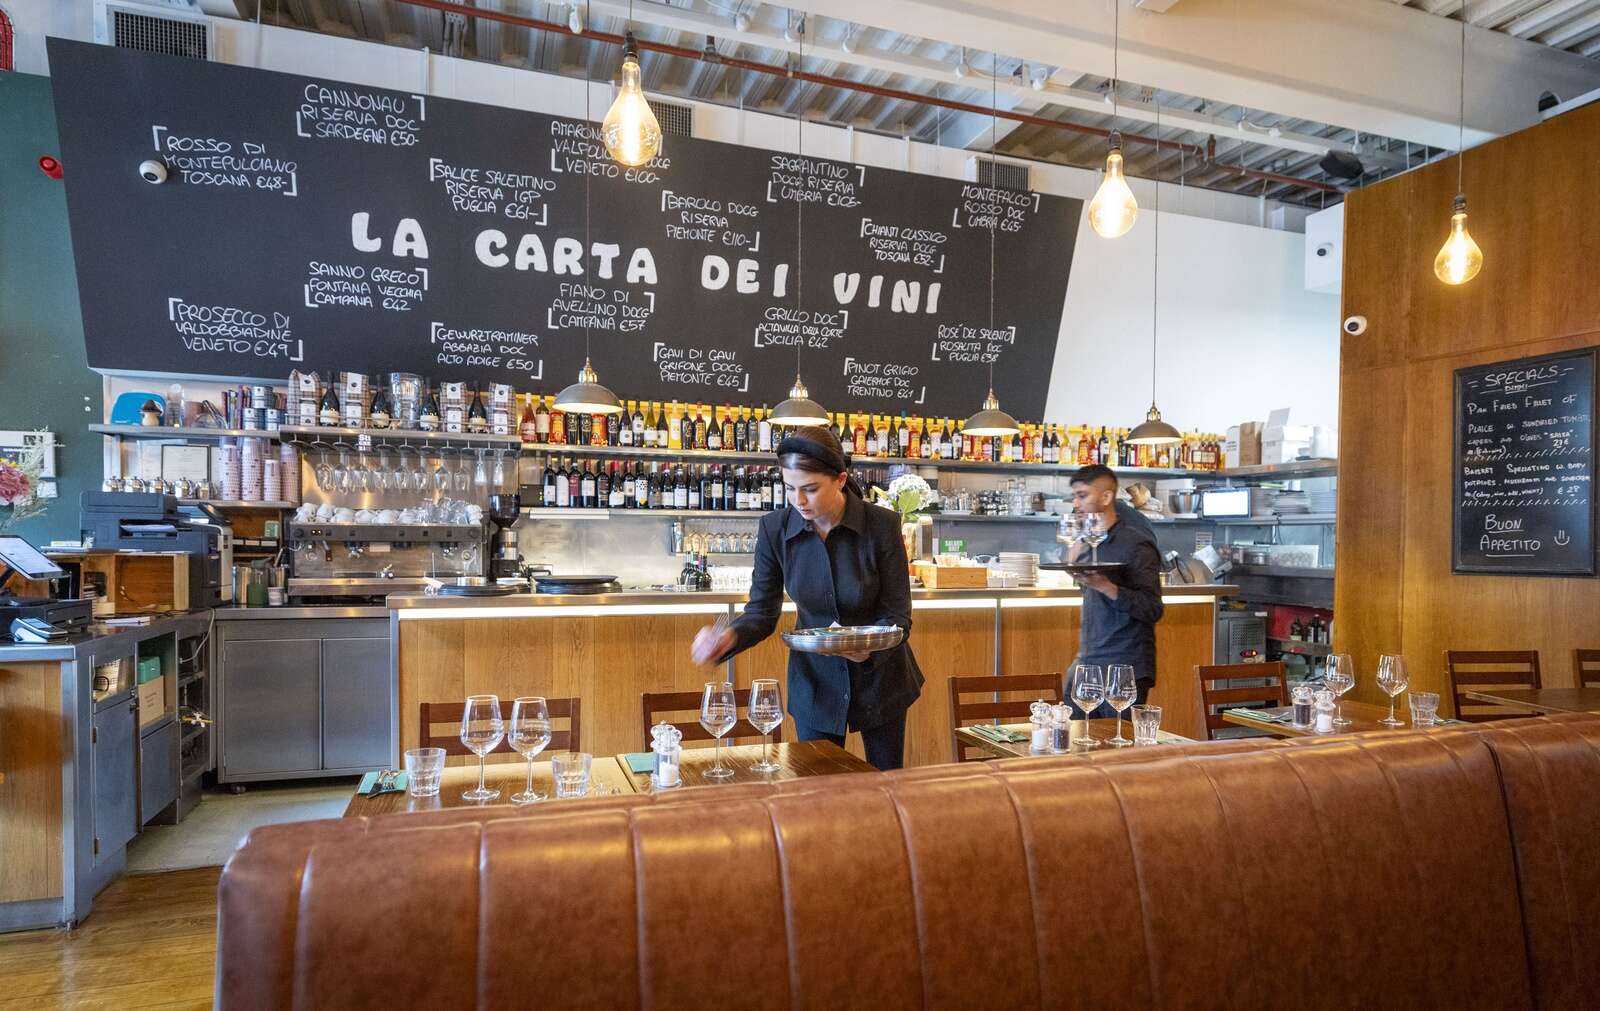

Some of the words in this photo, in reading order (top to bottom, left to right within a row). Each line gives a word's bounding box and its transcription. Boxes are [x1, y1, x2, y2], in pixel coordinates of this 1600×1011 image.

[304, 84, 405, 113] CANNONAU
[300, 103, 377, 125] RISERVA
[386, 114, 420, 131] DOC
[315, 122, 387, 145] SARDEGNA
[166, 136, 232, 153] ROSSO
[243, 142, 265, 154] DI
[162, 153, 297, 174] MONTEPULCIANO
[565, 156, 619, 178] VENETO
[770, 155, 849, 179] SAGRANTINO
[180, 169, 251, 188] TOSCANA
[432, 164, 479, 182] SALICE
[485, 170, 557, 191] SALENTINO
[807, 176, 854, 195] RISERVA
[445, 180, 504, 200] RISERVA
[514, 191, 542, 203] IGP
[781, 185, 822, 202] UMBRIA
[961, 185, 1031, 207] MONTEFALCO
[452, 196, 497, 214] PUGLIA
[667, 194, 721, 212] BAROLO
[728, 203, 759, 217] DOCG
[964, 200, 1003, 215] ROSSO
[1007, 207, 1025, 221] DOC
[681, 211, 729, 228] RISERVA
[968, 215, 998, 228] UMBRIA
[666, 224, 716, 242] PIEMONTE
[864, 223, 899, 238] CHIANTI
[901, 228, 947, 244] CLASSICO
[869, 239, 908, 252] RISERVA
[913, 242, 936, 254] DOCG
[875, 249, 910, 262] TOSCANA
[351, 212, 429, 259] LA
[475, 229, 658, 285] CARTA
[701, 254, 789, 297] DEI
[833, 272, 941, 314] VINI
[371, 267, 419, 285] GRECO
[309, 278, 371, 294] FONTANA
[378, 284, 422, 301] VECCHIA
[559, 283, 606, 301] FIANO
[613, 290, 629, 303] DI
[177, 303, 266, 327] PROSECCO
[273, 311, 290, 329] DI
[552, 299, 617, 317] AVELLINO
[622, 306, 650, 318] DOCG
[764, 307, 810, 323] GRILLO
[813, 312, 839, 325] DOC
[559, 314, 616, 330] CAMPANIA
[175, 321, 293, 342] VALDOBBIADINE
[436, 328, 538, 346] GEWURZTRAMINER
[763, 332, 804, 346] SICILIA
[820, 327, 844, 339] CORTE
[938, 324, 963, 339] ROSÉ
[963, 327, 978, 339] DEL
[979, 328, 1012, 342] SALENTO
[182, 336, 251, 352] VENETO
[253, 342, 288, 358] €49
[442, 341, 492, 353] ABBAZIA
[500, 346, 527, 356] DOC
[658, 347, 684, 360] GAVI
[689, 348, 702, 359] DI
[709, 349, 736, 361] GAVI
[940, 341, 981, 352] ROSALITA
[987, 343, 1002, 353] DOC
[437, 353, 464, 365] ALTO
[466, 355, 502, 368] ADIGE
[949, 352, 979, 362] PUGLIA
[659, 360, 707, 372] GRIFONE
[712, 363, 744, 373] DOCG
[847, 361, 880, 375] PINOT
[883, 363, 919, 376] GRIGIO
[660, 371, 715, 385] PIEMONTE
[894, 377, 910, 387] DOC
[1484, 365, 1559, 387] SPECIALS
[848, 385, 893, 398] TRENTINO
[1493, 399, 1517, 413] FRIED
[1525, 396, 1552, 408] FILLET
[1562, 394, 1577, 404] OF
[1468, 424, 1494, 434] PLAICE
[1484, 513, 1523, 530] BUON
[1480, 534, 1541, 551] APPETITO
